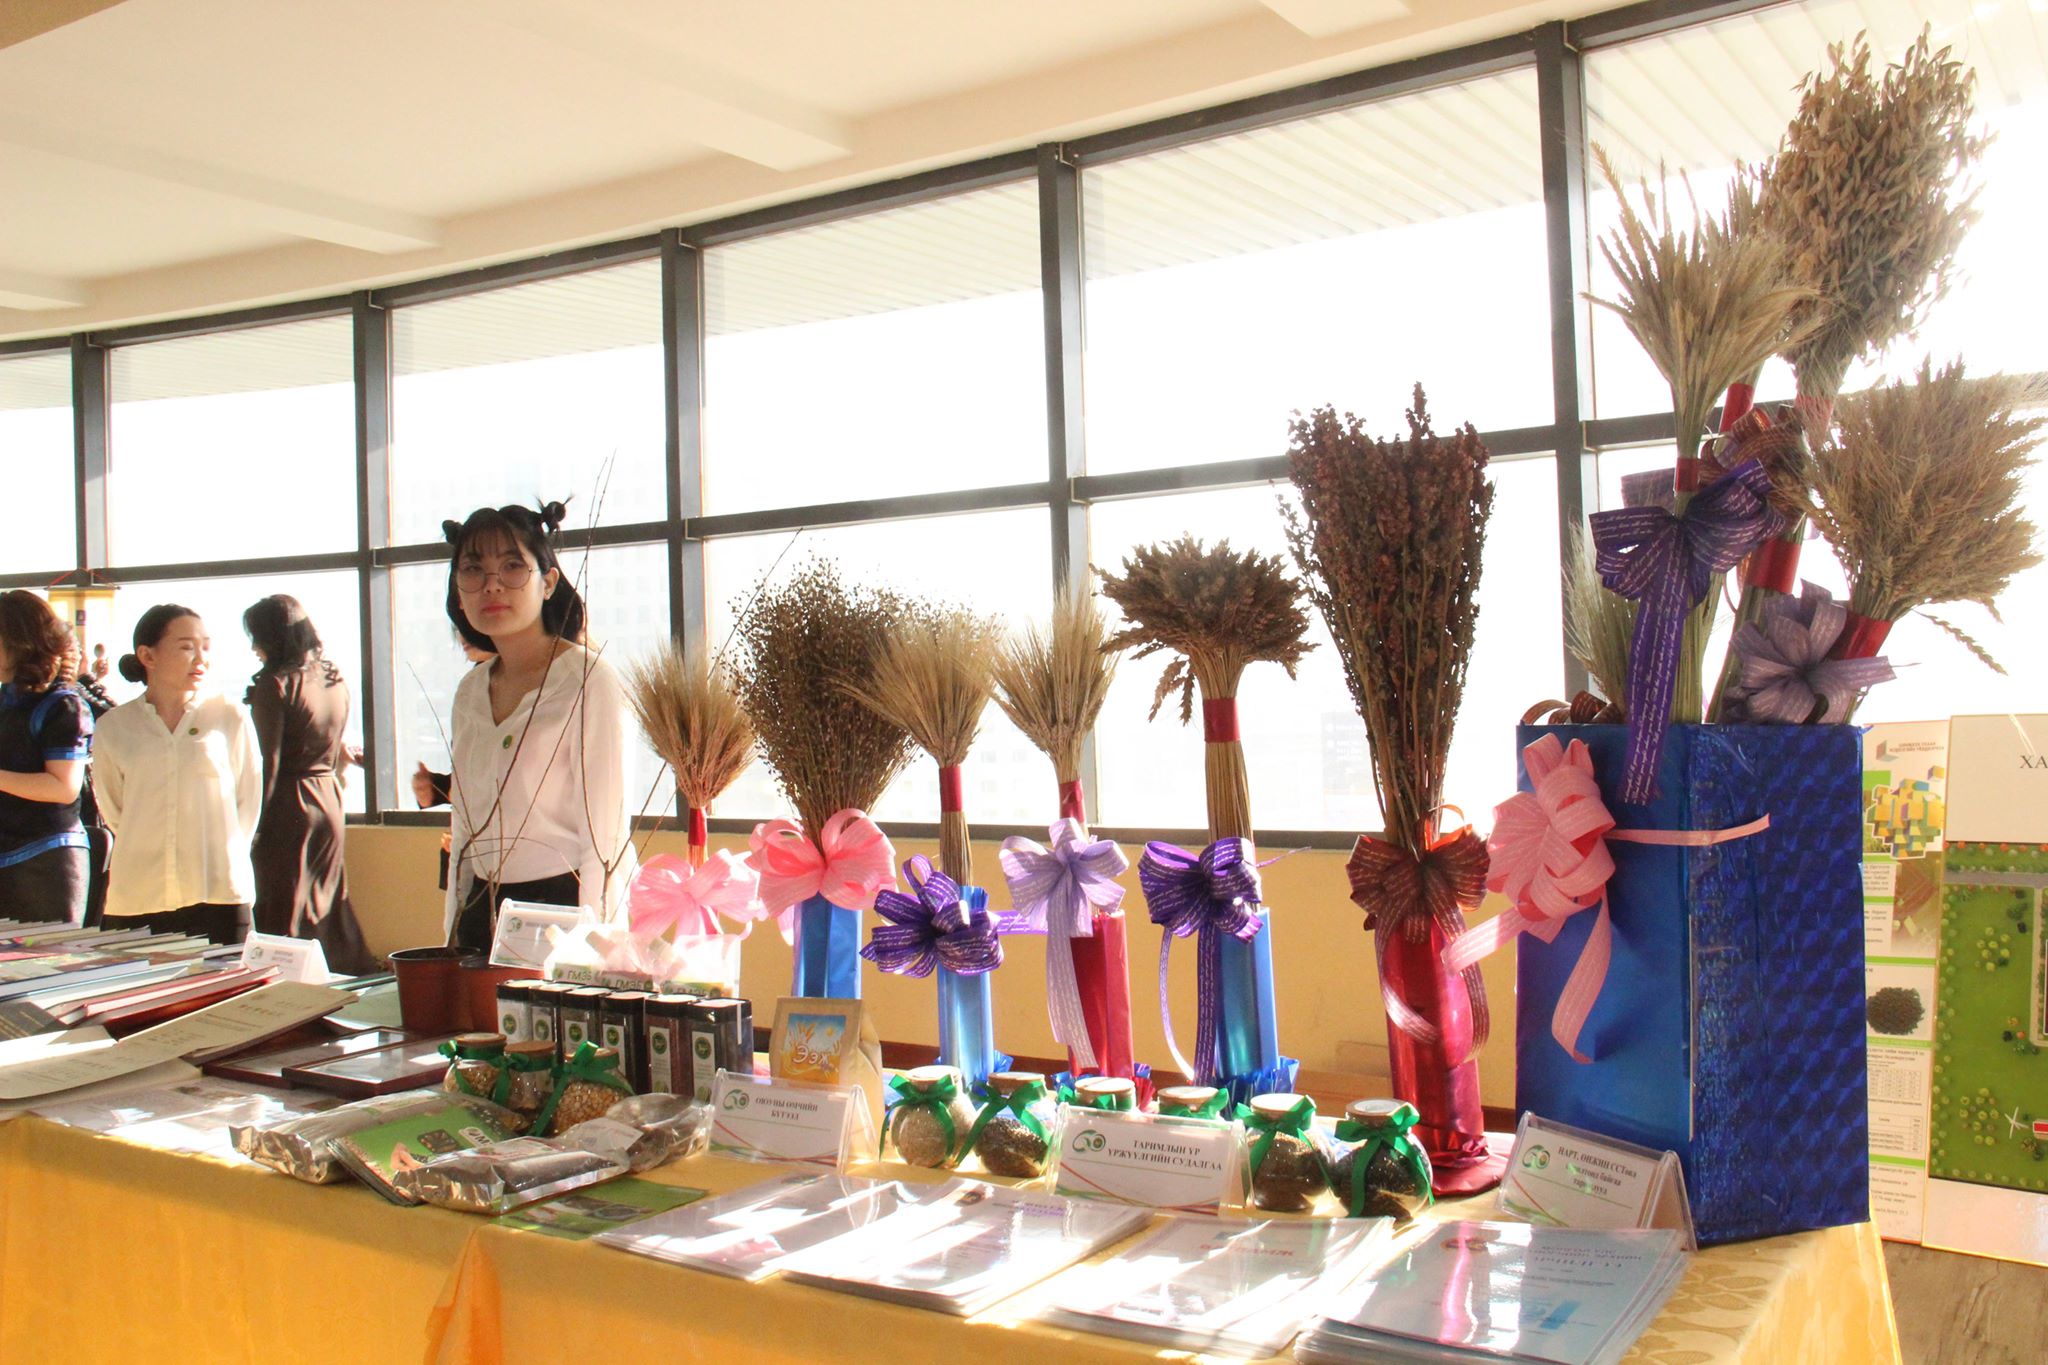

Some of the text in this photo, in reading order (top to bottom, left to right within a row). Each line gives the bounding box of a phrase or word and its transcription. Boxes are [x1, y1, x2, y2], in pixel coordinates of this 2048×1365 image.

[1133, 1140, 1201, 1156] ТАРИМЛЫН ҮР
[1108, 1149, 1223, 1171] ҮРЖҮҮЛГИЙН СУДАЛГАА
